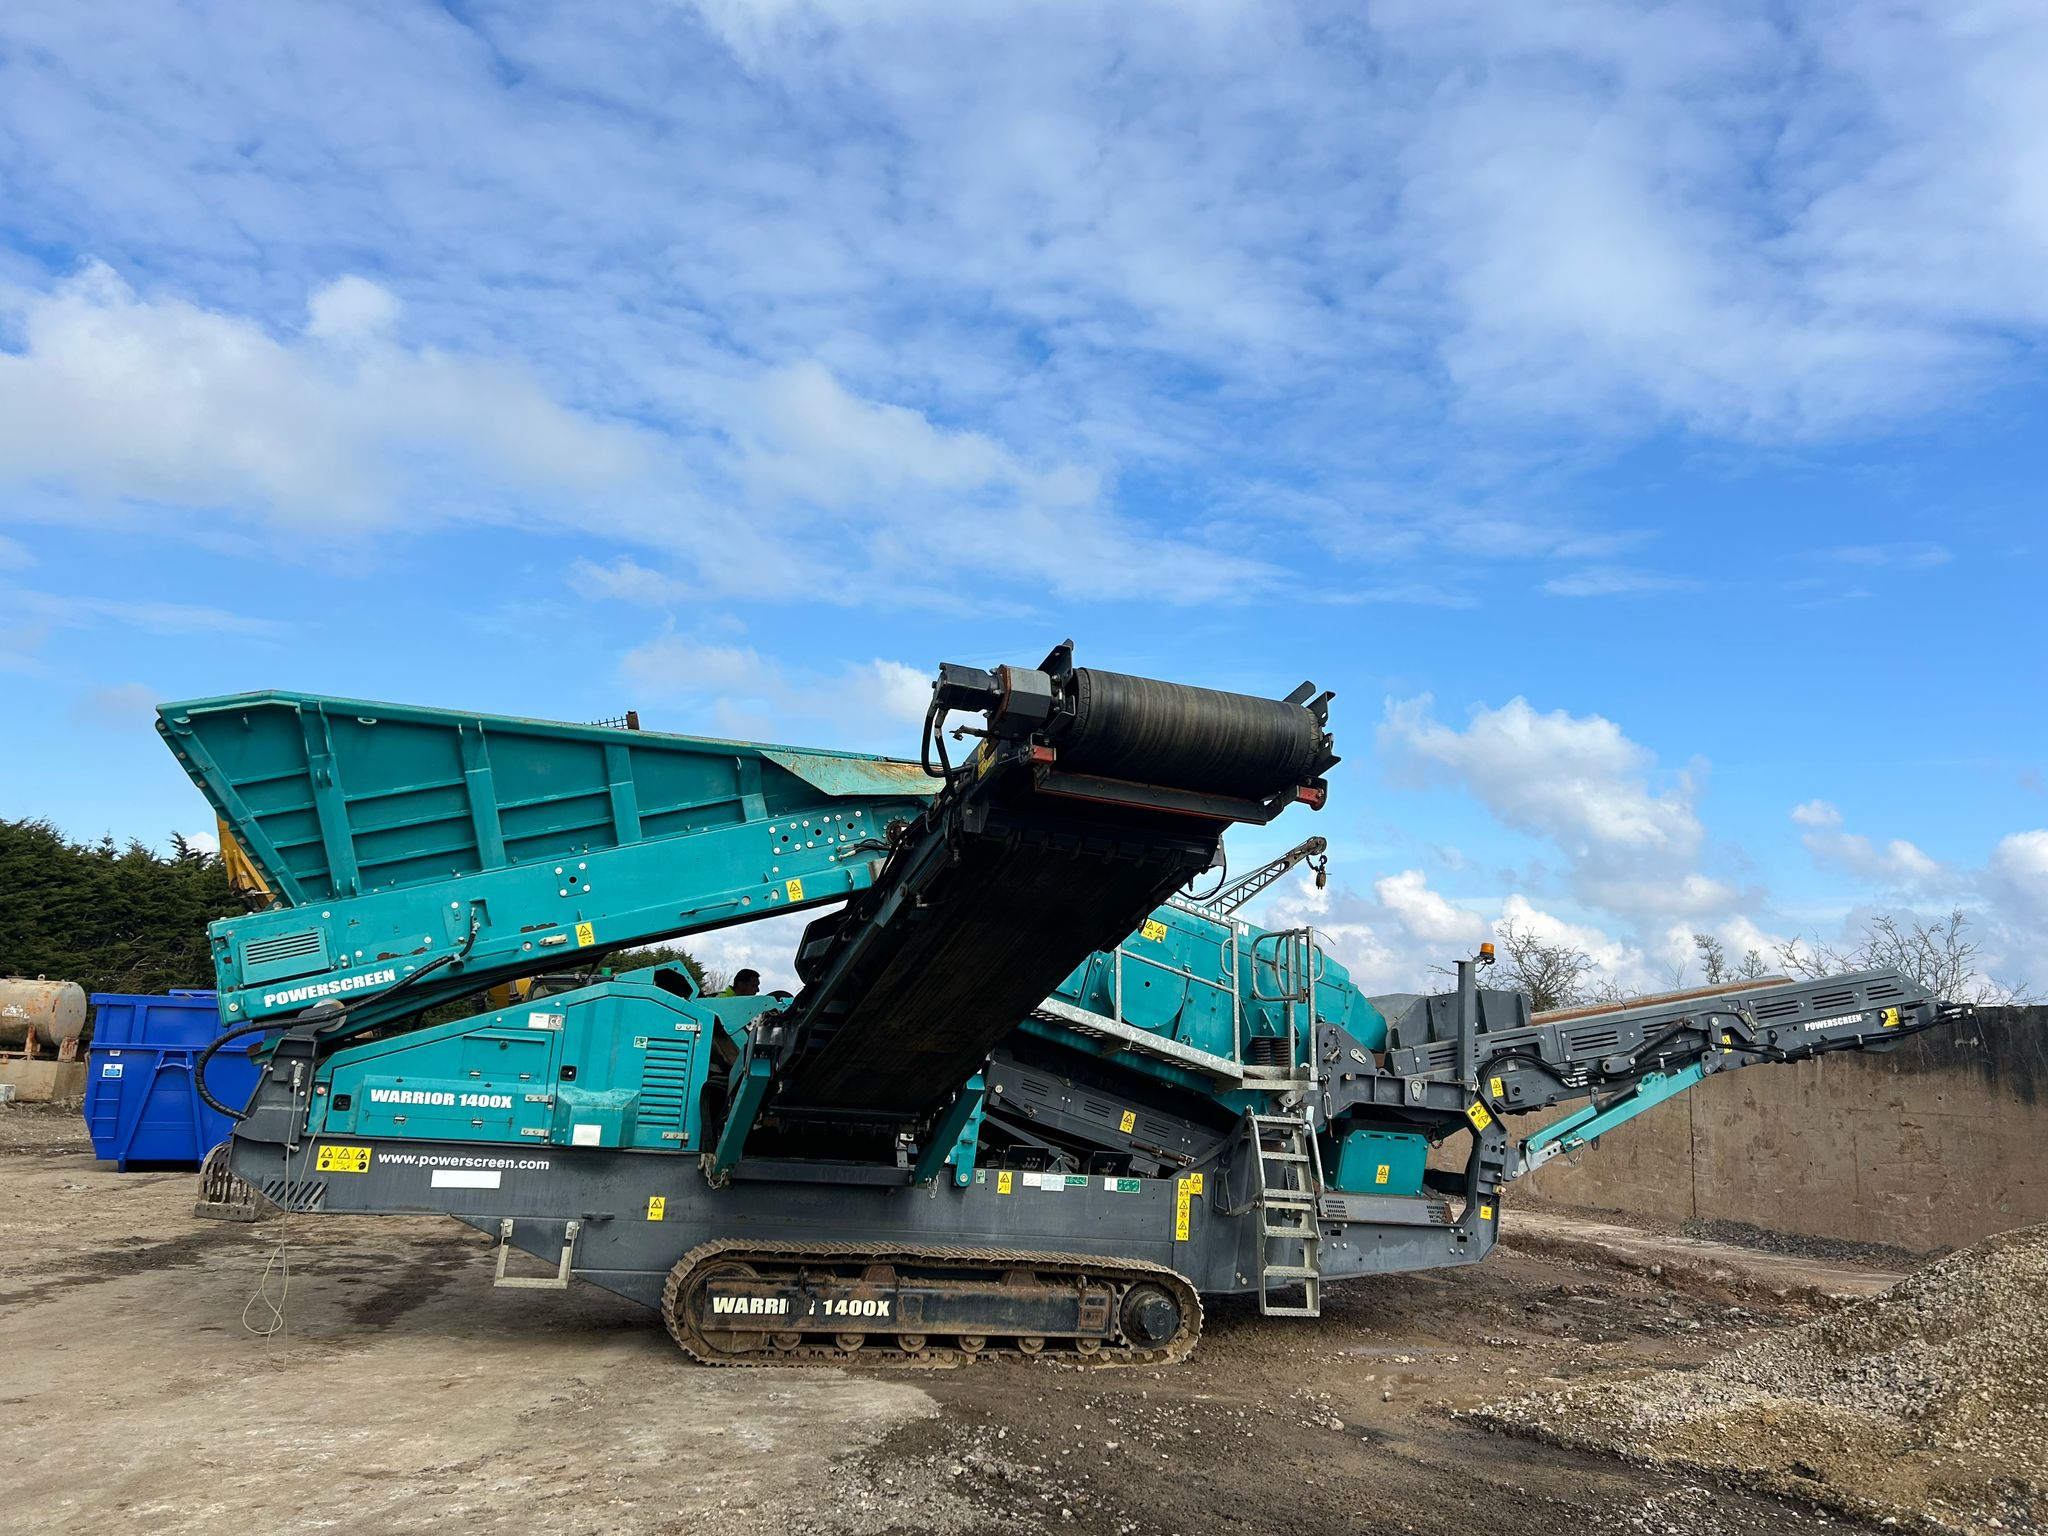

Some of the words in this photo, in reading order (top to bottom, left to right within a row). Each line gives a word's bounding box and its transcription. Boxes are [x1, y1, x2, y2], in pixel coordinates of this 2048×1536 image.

[263, 968, 396, 1008] POWERSCREEN
[1804, 1013, 1863, 1032] POWERSCREEN
[370, 1089, 455, 1106] WARRIOR
[458, 1093, 512, 1109] 1400X
[378, 1153, 550, 1170] www.powerscreen.com
[712, 1297, 816, 1316] WARRI
[823, 1299, 890, 1317] 1400X
